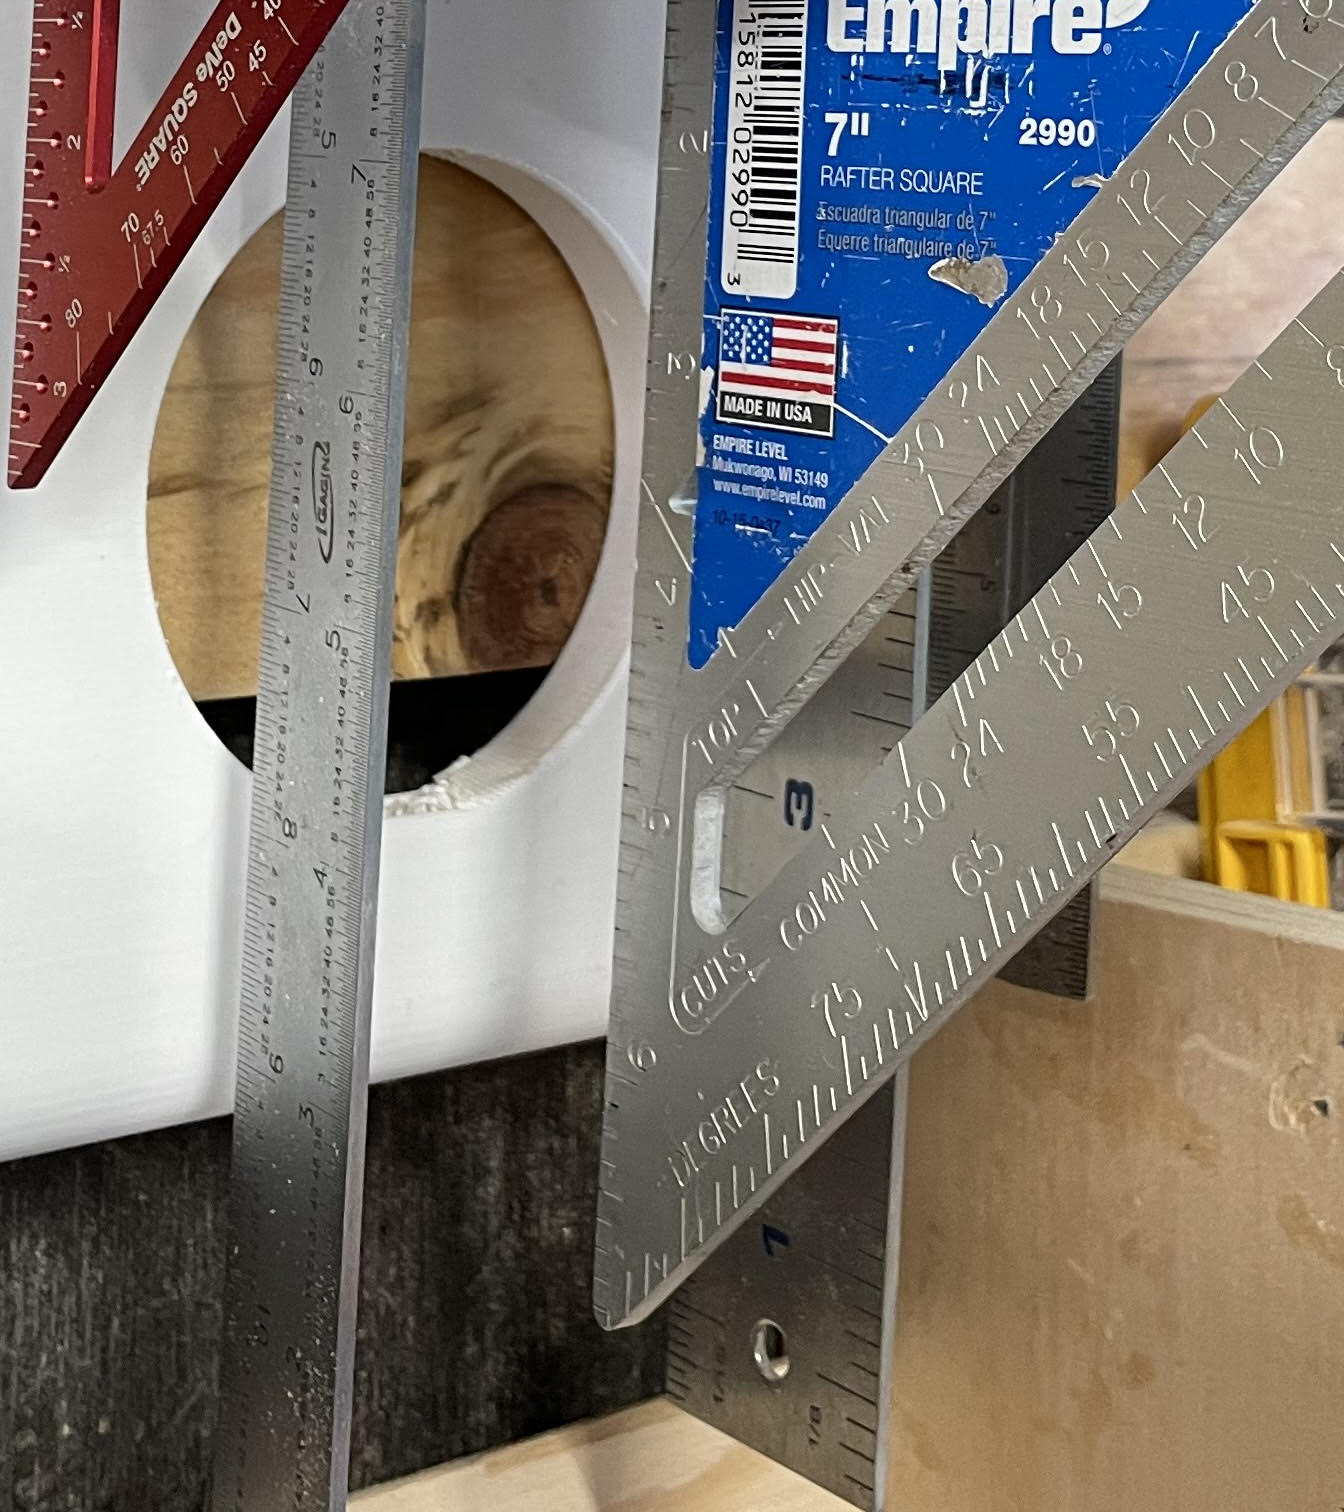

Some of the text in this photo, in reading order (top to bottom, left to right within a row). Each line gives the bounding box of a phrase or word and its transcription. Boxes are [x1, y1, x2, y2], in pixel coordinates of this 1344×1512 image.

[248, 40, 267, 72] 45
[1254, 15, 1287, 61] 7
[216, 61, 235, 92] 50
[735, 12, 757, 110] 15812
[1223, 60, 1259, 104] 8
[67, 134, 81, 150] 2
[134, 82, 198, 186] SQUARE
[170, 134, 189, 166] 60
[321, 129, 336, 149] 5
[1019, 118, 1096, 148] 2990
[1168, 108, 1216, 167] 10
[729, 126, 752, 228] 02990
[820, 165, 984, 195] RAFTER SQUARE
[1116, 169, 1167, 227] 12
[121, 212, 140, 243] 70
[816, 201, 881, 225] Escuadra
[885, 206, 953, 232] triangular
[957, 210, 975, 230] de
[874, 234, 953, 260] triangulaire
[957, 240, 975, 259] de
[1062, 228, 1111, 288] 15
[727, 272, 741, 286] 3
[65, 298, 83, 329] 80
[1016, 285, 1063, 340] 18
[309, 357, 324, 376] 6
[53, 381, 67, 398] 3
[724, 395, 812, 424] MADE IN USA
[713, 434, 789, 461] EMPIRE LEVEL
[1234, 425, 1285, 486] 10
[712, 455, 829, 489] Mukwonago, WI 53149
[712, 479, 826, 510] www.empirelevel.com
[1171, 494, 1222, 551] 12
[296, 593, 310, 614] 7
[1097, 580, 1144, 631] 15
[1219, 556, 1276, 624] 45
[298, 162, 367, 1128] 7 6 5 4 3
[1039, 635, 1085, 691] 18
[1082, 700, 1141, 763] 55
[785, 778, 814, 831] 3
[902, 777, 947, 846] 30
[282, 817, 297, 839] 8
[780, 823, 890, 952] COMMON
[952, 836, 1004, 898] 65
[681, 939, 748, 1019] CUTS
[809, 982, 863, 1039] 75
